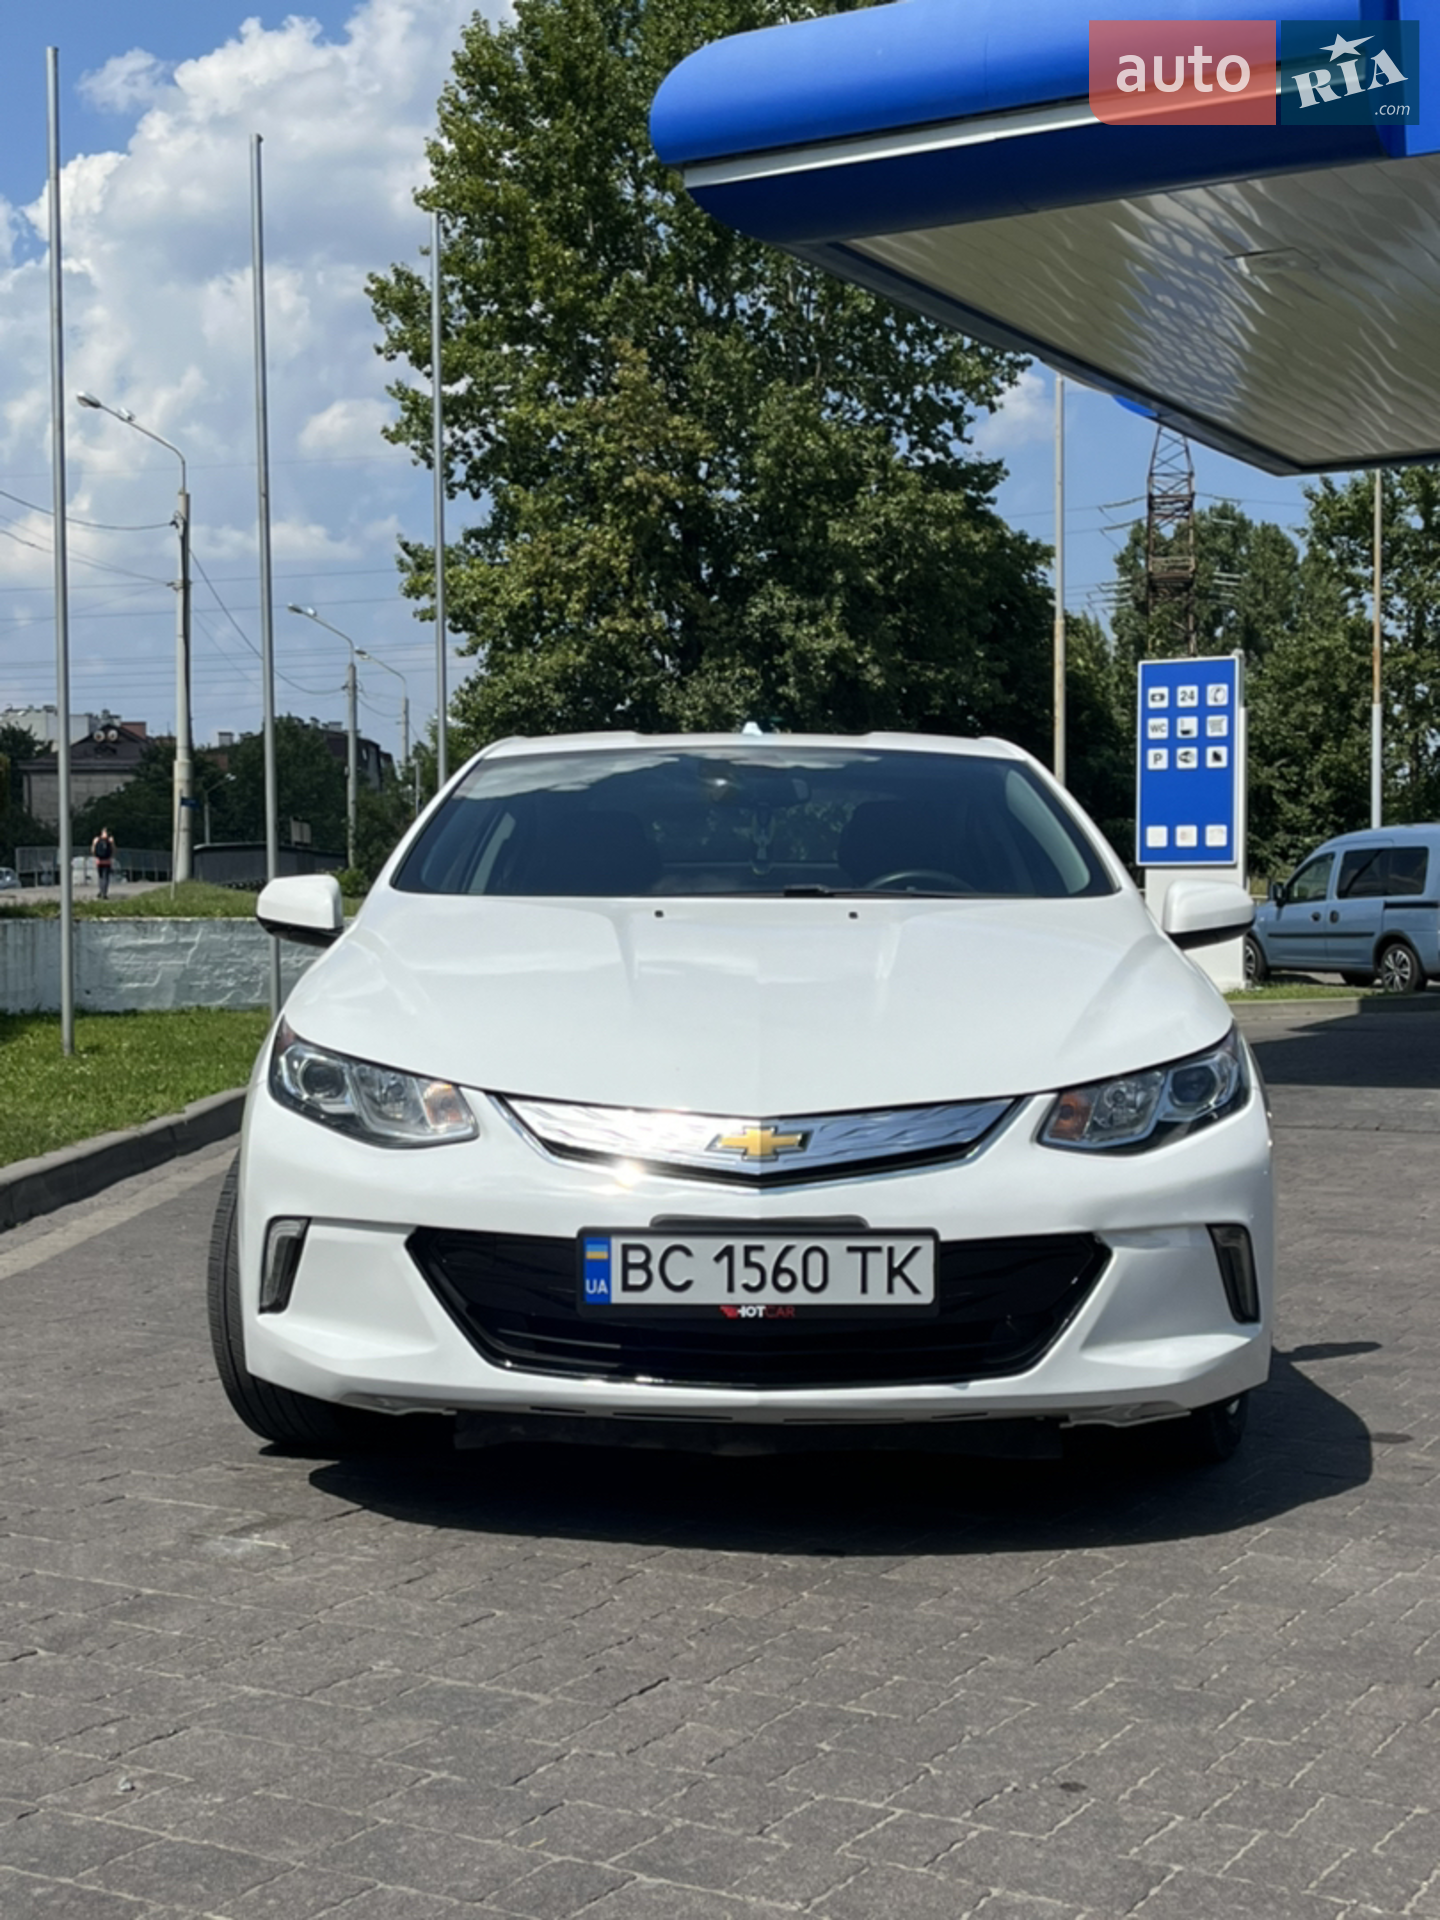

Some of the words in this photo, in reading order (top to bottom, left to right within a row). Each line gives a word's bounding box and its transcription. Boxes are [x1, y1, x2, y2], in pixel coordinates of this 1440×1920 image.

[1180, 690, 1195, 702] 24
[1150, 723, 1167, 733] WC
[1153, 753, 1163, 765] P
[621, 1243, 694, 1293] BC
[712, 1244, 829, 1294] 1560
[846, 1245, 923, 1295] TK
[585, 1278, 609, 1294] UA
